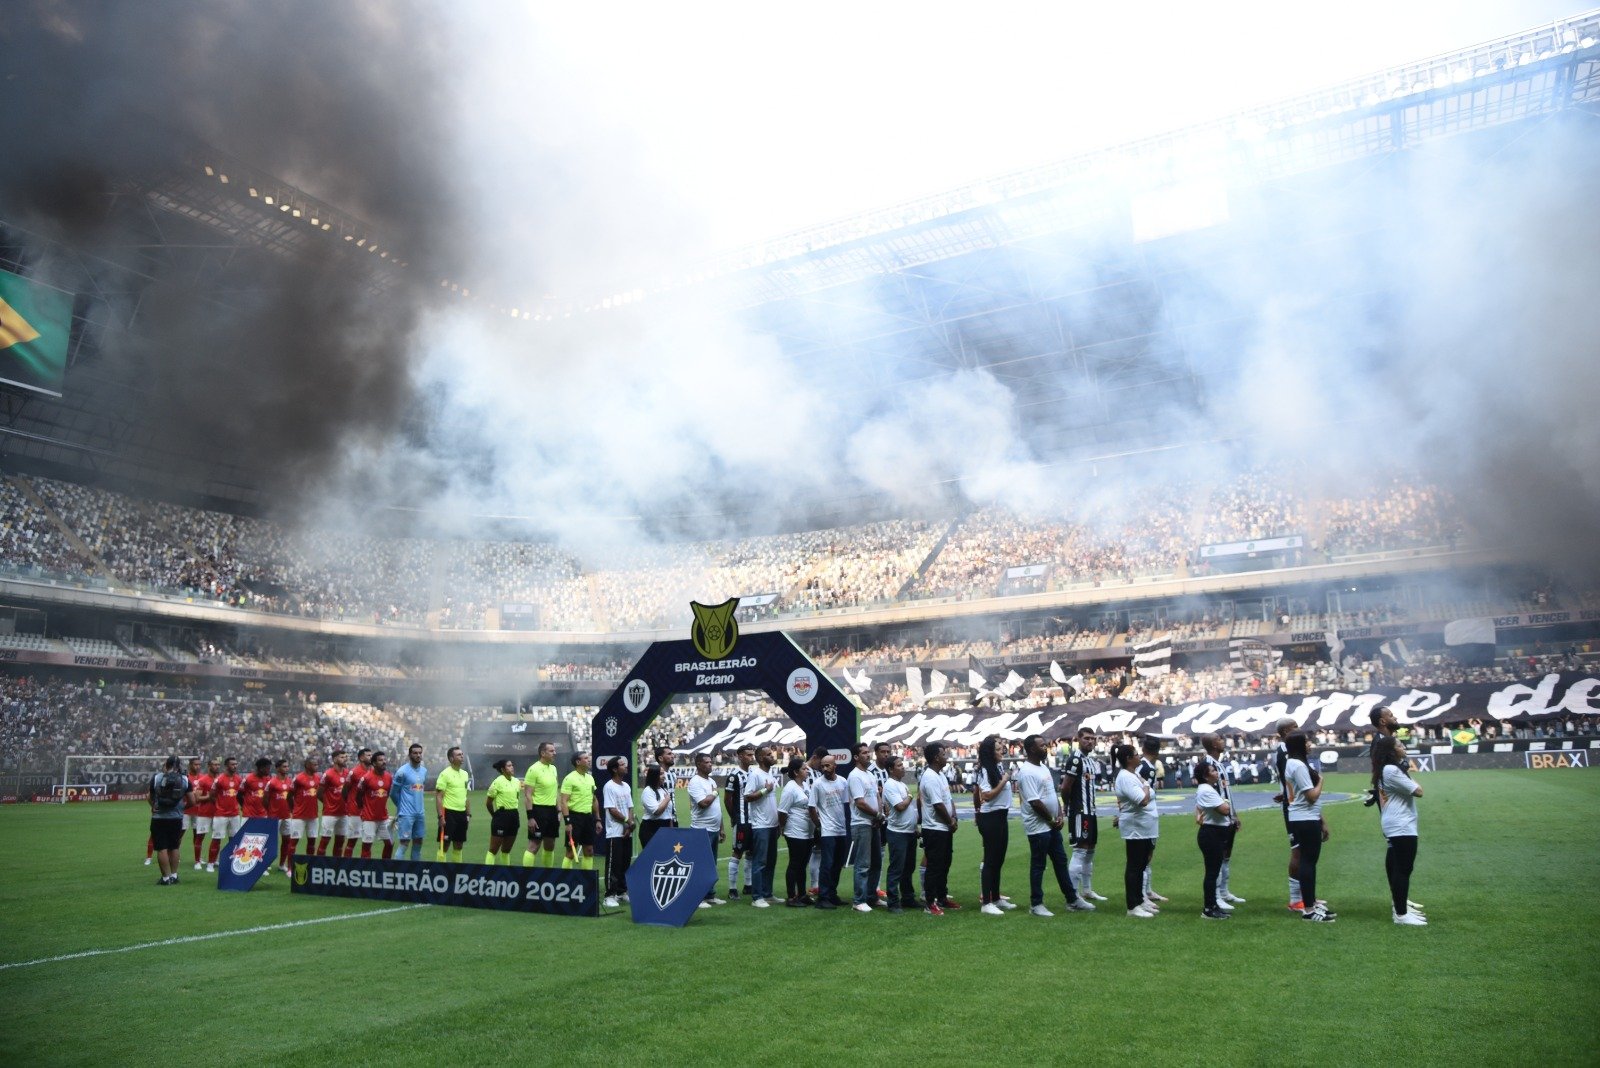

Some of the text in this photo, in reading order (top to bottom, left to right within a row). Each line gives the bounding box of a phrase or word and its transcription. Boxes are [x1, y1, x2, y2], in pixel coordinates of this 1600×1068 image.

[1493, 617, 1519, 626] NCER
[1528, 612, 1570, 624] VENCER
[74, 655, 109, 666] VENCER
[115, 658, 149, 669] VENCER
[155, 662, 187, 672] VENCER
[674, 656, 757, 672] BRASILEIRÃO
[696, 674, 735, 686] Betano
[1161, 689, 1460, 736] nome
[1486, 673, 1600, 720] de
[1408, 757, 1431, 772] AX
[1531, 752, 1581, 769] BRAX
[657, 866, 687, 876] CAM
[311, 867, 586, 903] BRASILEIRÃO Betano 2024
